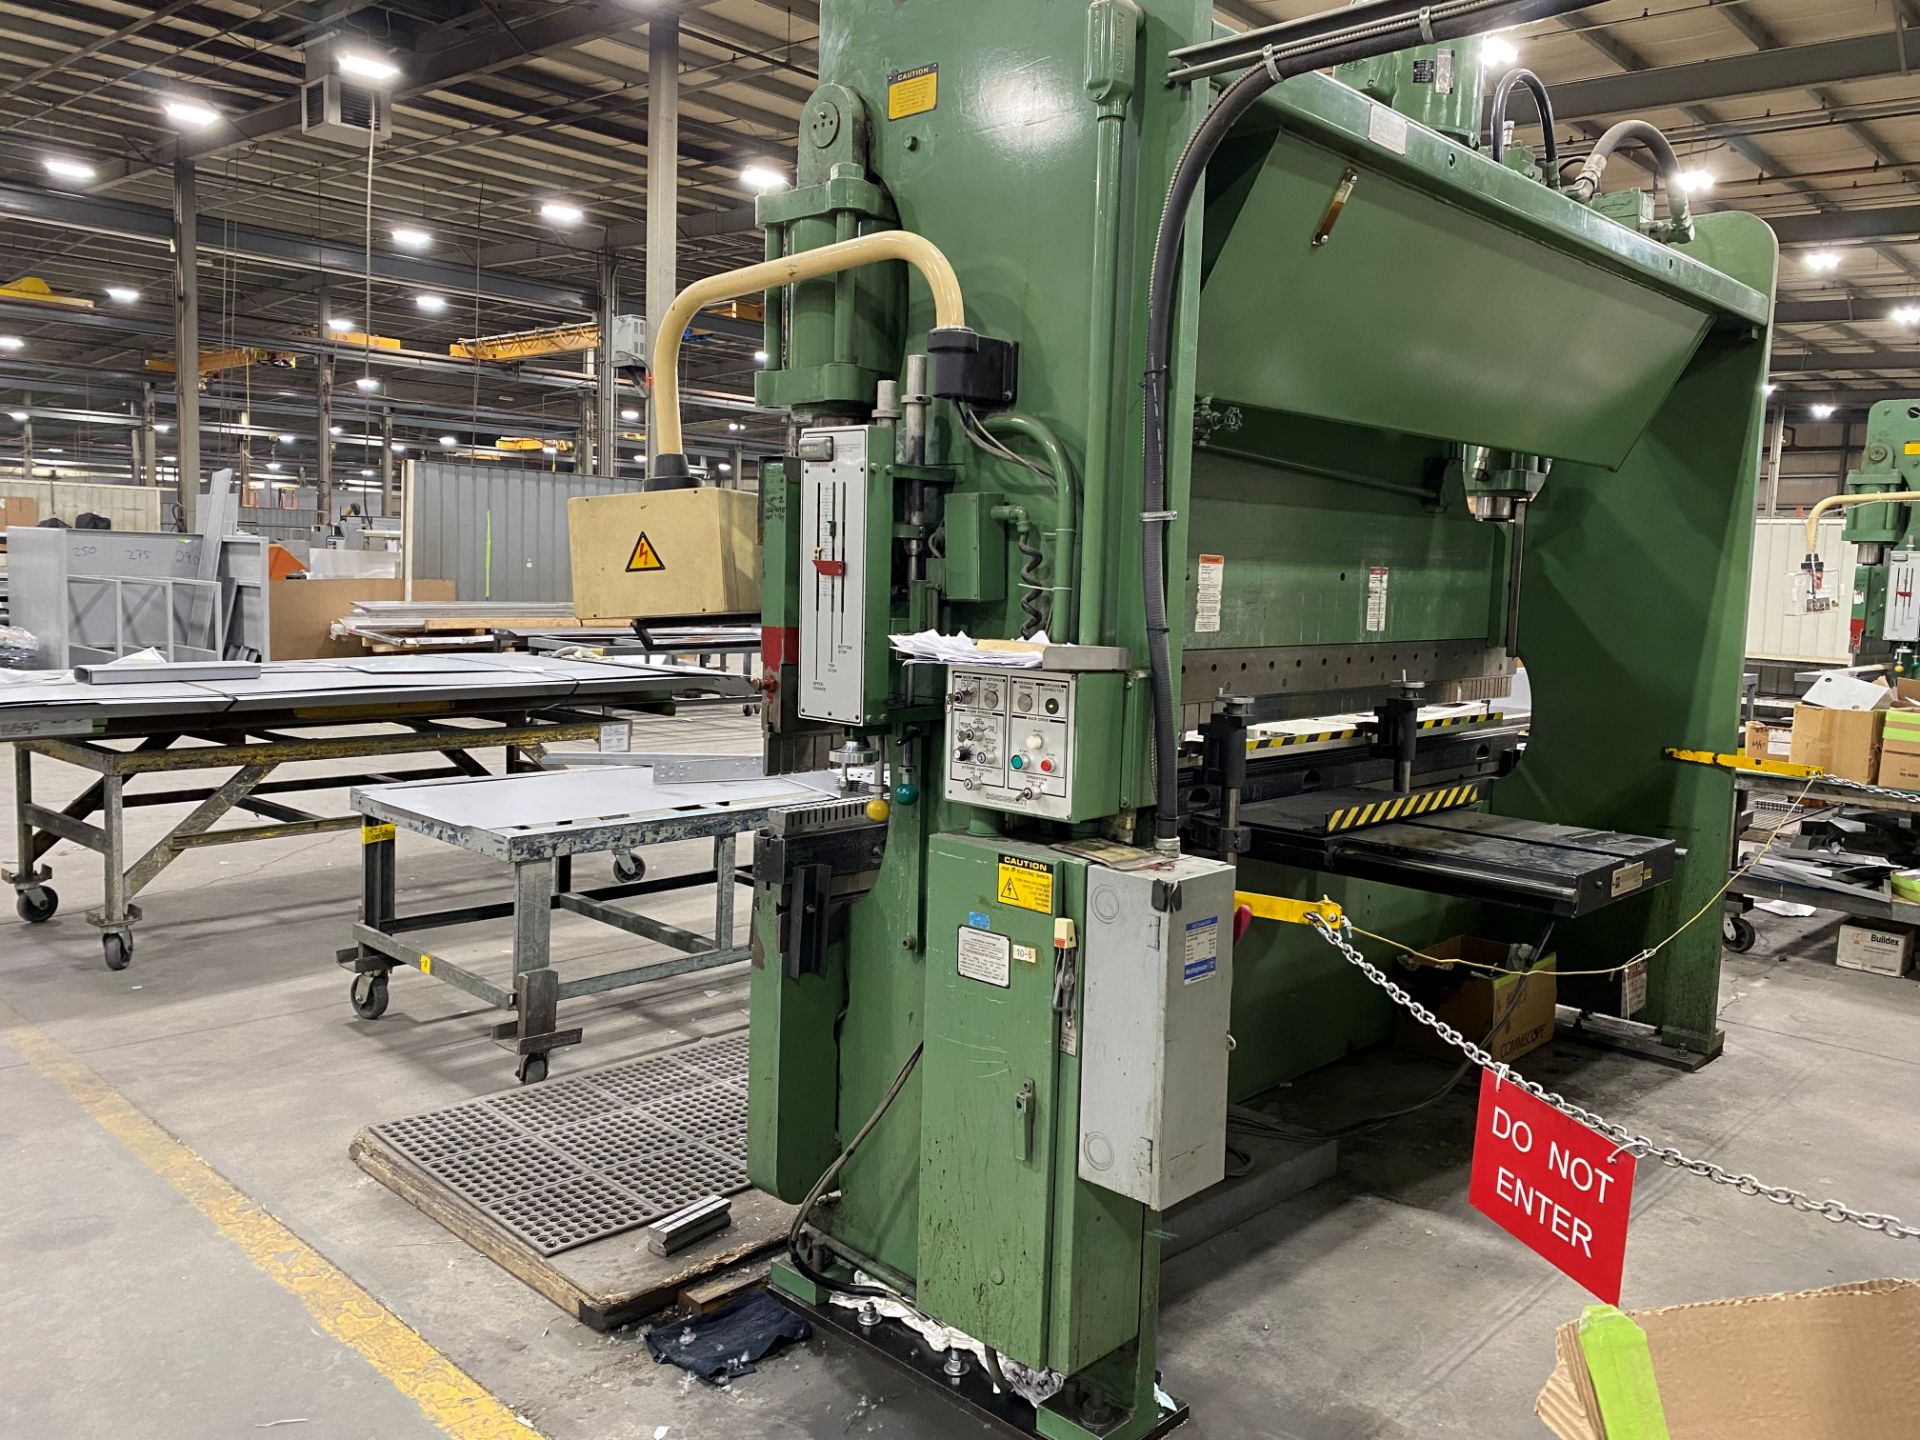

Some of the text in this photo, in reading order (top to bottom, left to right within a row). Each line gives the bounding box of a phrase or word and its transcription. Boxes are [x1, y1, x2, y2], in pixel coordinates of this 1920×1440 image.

[897, 67, 929, 81] CAUTION
[72, 545, 97, 557] 250
[126, 549, 151, 560] 275
[1004, 856, 1047, 872] CAUTION
[1871, 933, 1900, 947] Buildex
[1492, 1106, 1615, 1204] DO NOT
[1495, 1166, 1593, 1259] ENTER
